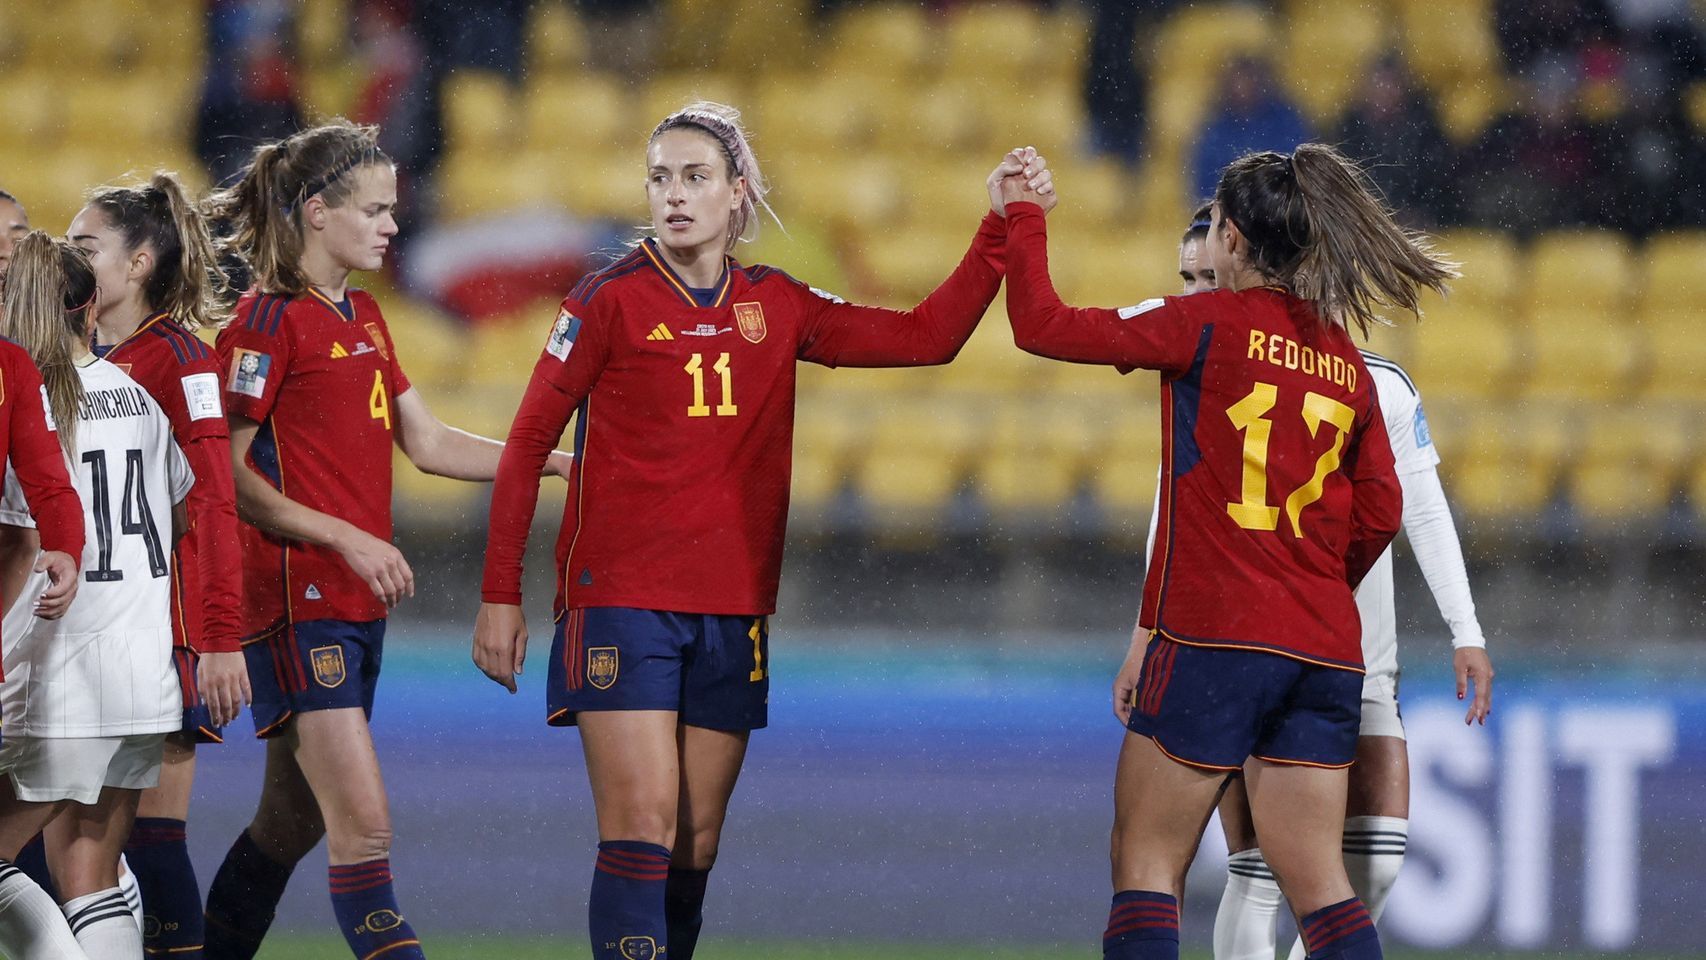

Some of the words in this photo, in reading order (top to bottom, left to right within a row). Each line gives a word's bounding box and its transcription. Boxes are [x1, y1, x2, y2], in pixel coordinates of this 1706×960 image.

[683, 352, 738, 417] 11
[1247, 329, 1357, 393] REDONDO
[369, 369, 391, 430] 4
[1225, 381, 1356, 539] 17
[81, 449, 169, 582] 14
